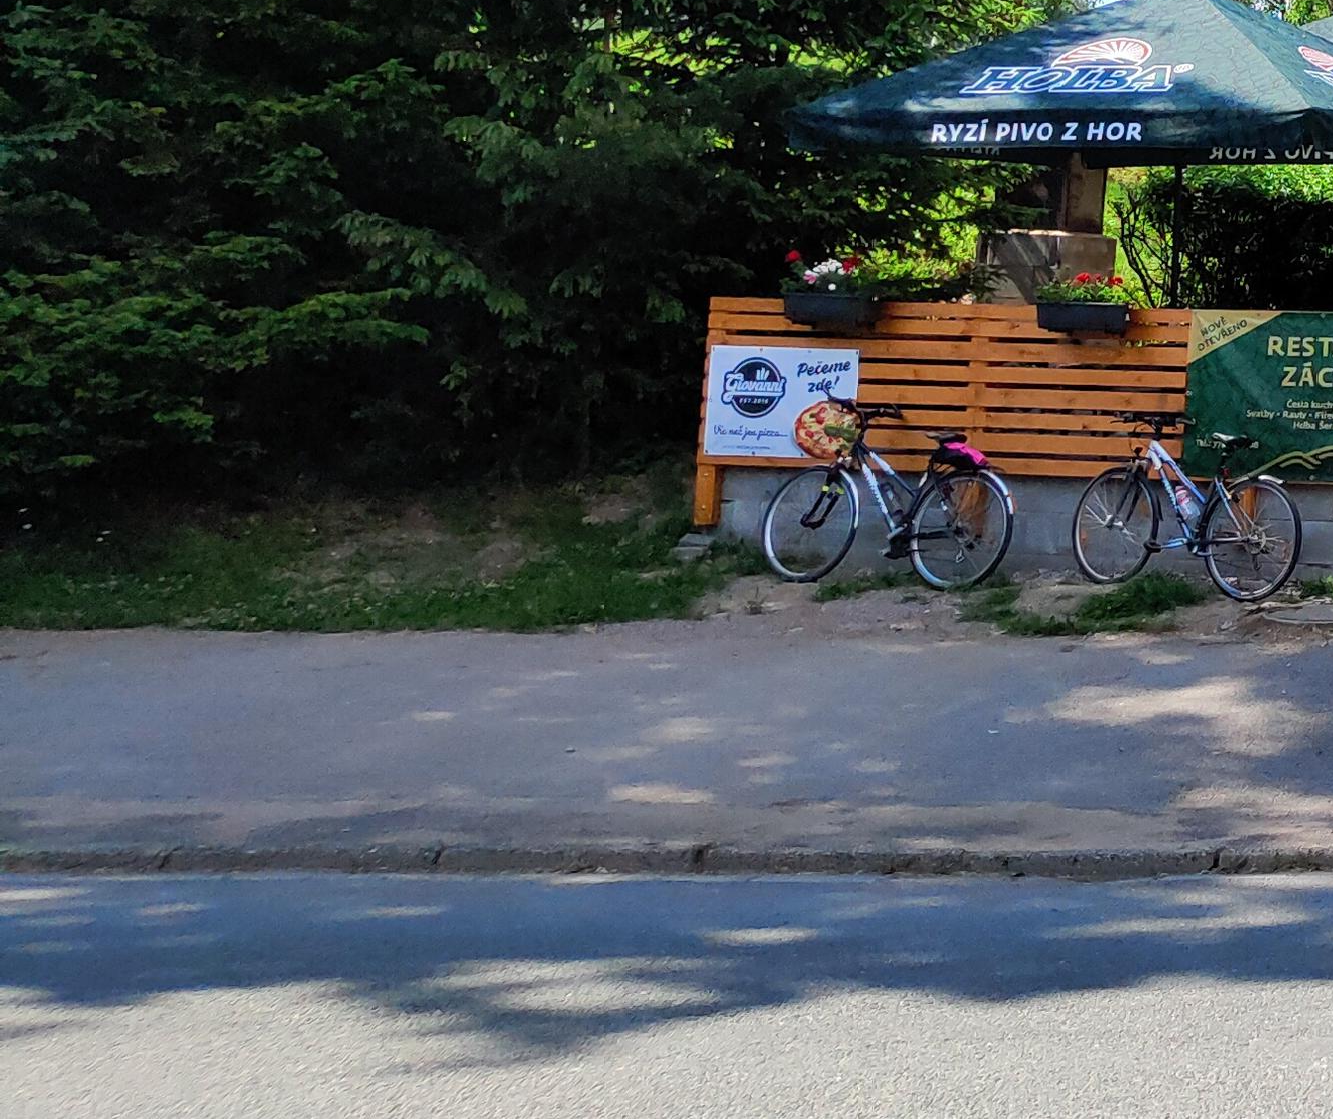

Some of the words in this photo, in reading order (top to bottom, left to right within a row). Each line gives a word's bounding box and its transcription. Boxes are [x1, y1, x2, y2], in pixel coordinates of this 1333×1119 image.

[959, 65, 1174, 93] HOLBA
[930, 118, 989, 142] RYZÍ
[995, 122, 1053, 141] PIVO
[1060, 122, 1078, 141] Z
[1087, 122, 1142, 141] HOR
[1198, 319, 1248, 351] OTEVŘENO
[1199, 316, 1228, 336] NOVĚ
[797, 361, 851, 377] Pečeme
[722, 372, 787, 403] Giovanni
[808, 376, 839, 393] zde!
